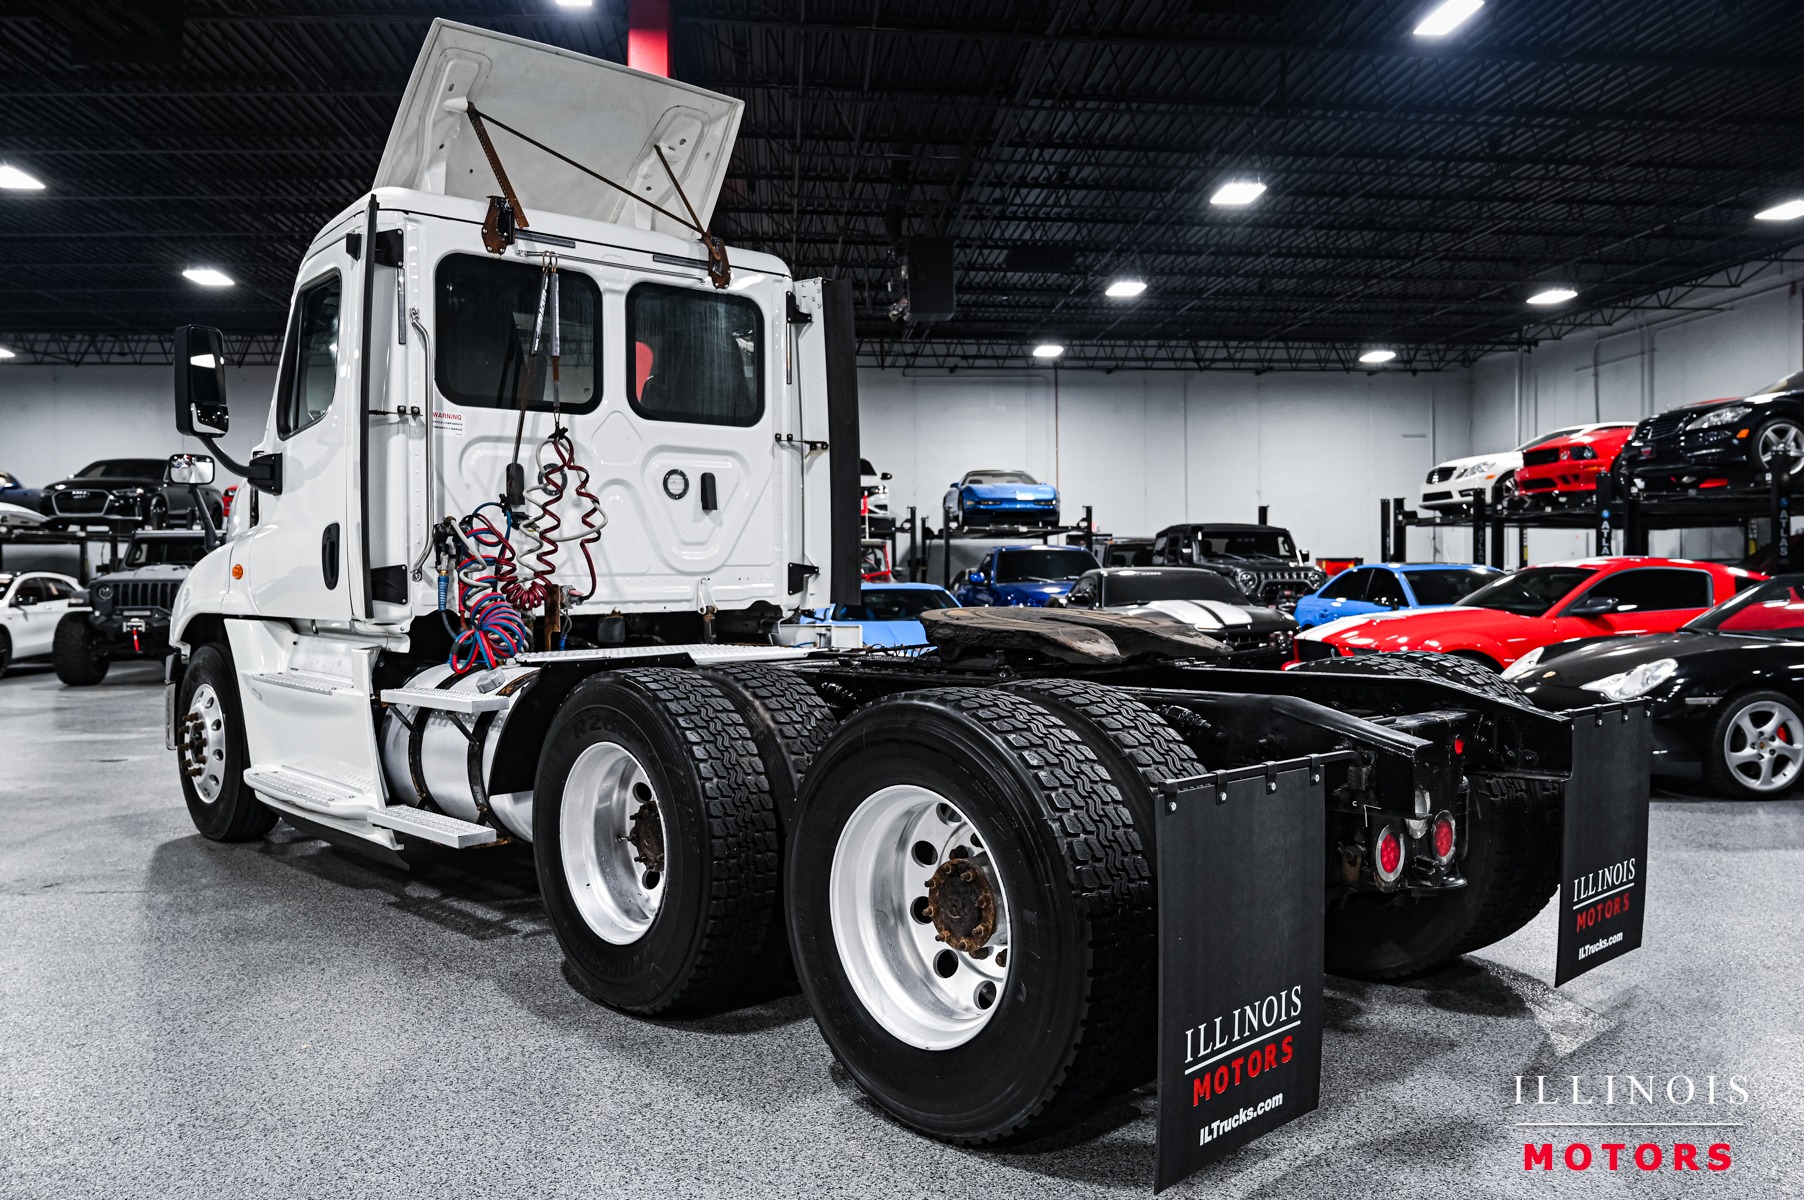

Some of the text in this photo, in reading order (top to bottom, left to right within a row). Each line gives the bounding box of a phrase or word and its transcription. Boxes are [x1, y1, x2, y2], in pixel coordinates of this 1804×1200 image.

[432, 411, 462, 421] WARNING
[1600, 520, 1610, 555] ATLA
[1779, 509, 1789, 556] ATLAS
[1573, 857, 1636, 902] ILLINOIS
[1576, 892, 1630, 933] MOTORS
[1578, 931, 1623, 961] ILTrucks.com
[1184, 984, 1302, 1064] ILLINOIS
[1193, 1035, 1293, 1107] MOTORS
[1199, 1092, 1284, 1147] ILTrucks.com
